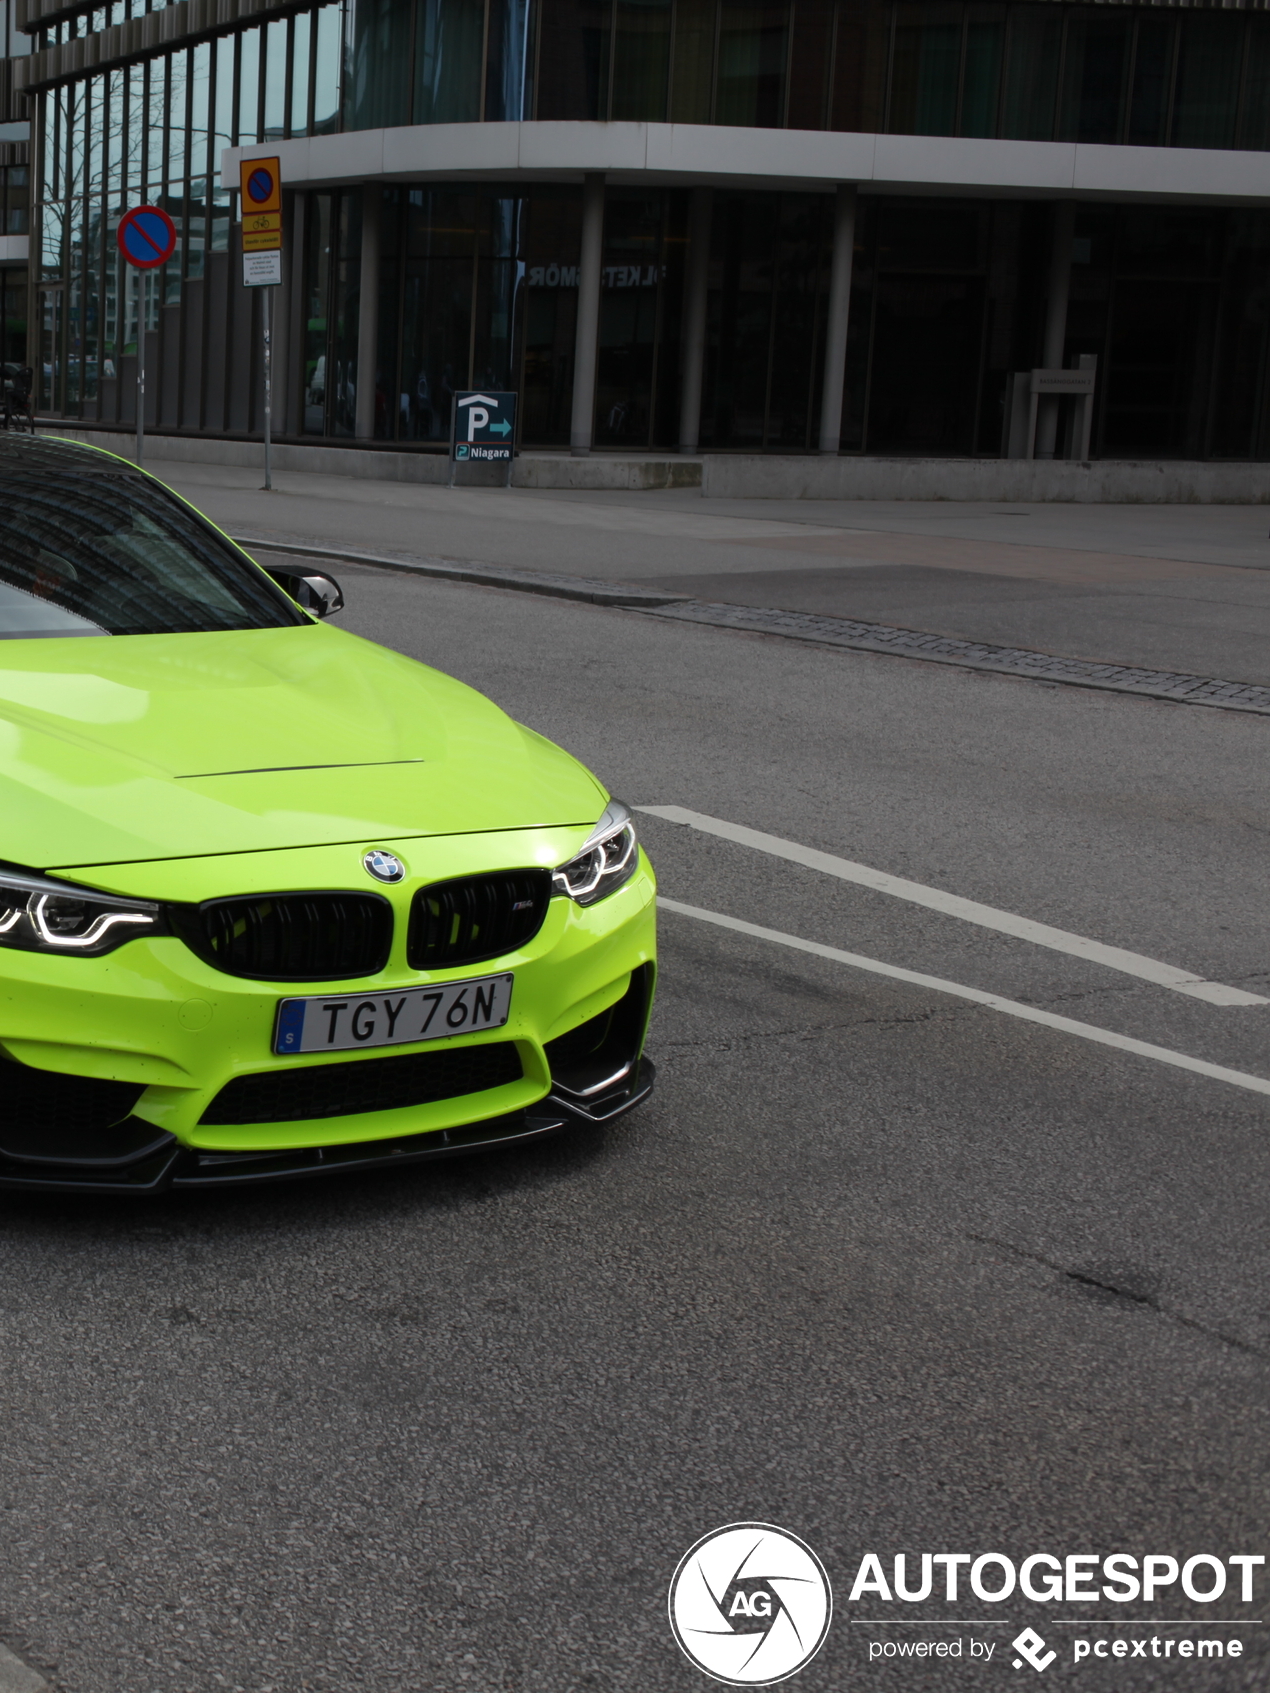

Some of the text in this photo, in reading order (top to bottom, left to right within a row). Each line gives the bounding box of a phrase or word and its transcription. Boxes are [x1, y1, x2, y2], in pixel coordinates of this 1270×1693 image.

[468, 407, 489, 442] P
[470, 447, 510, 460] Niagara
[285, 983, 496, 1044] S TGY 76N
